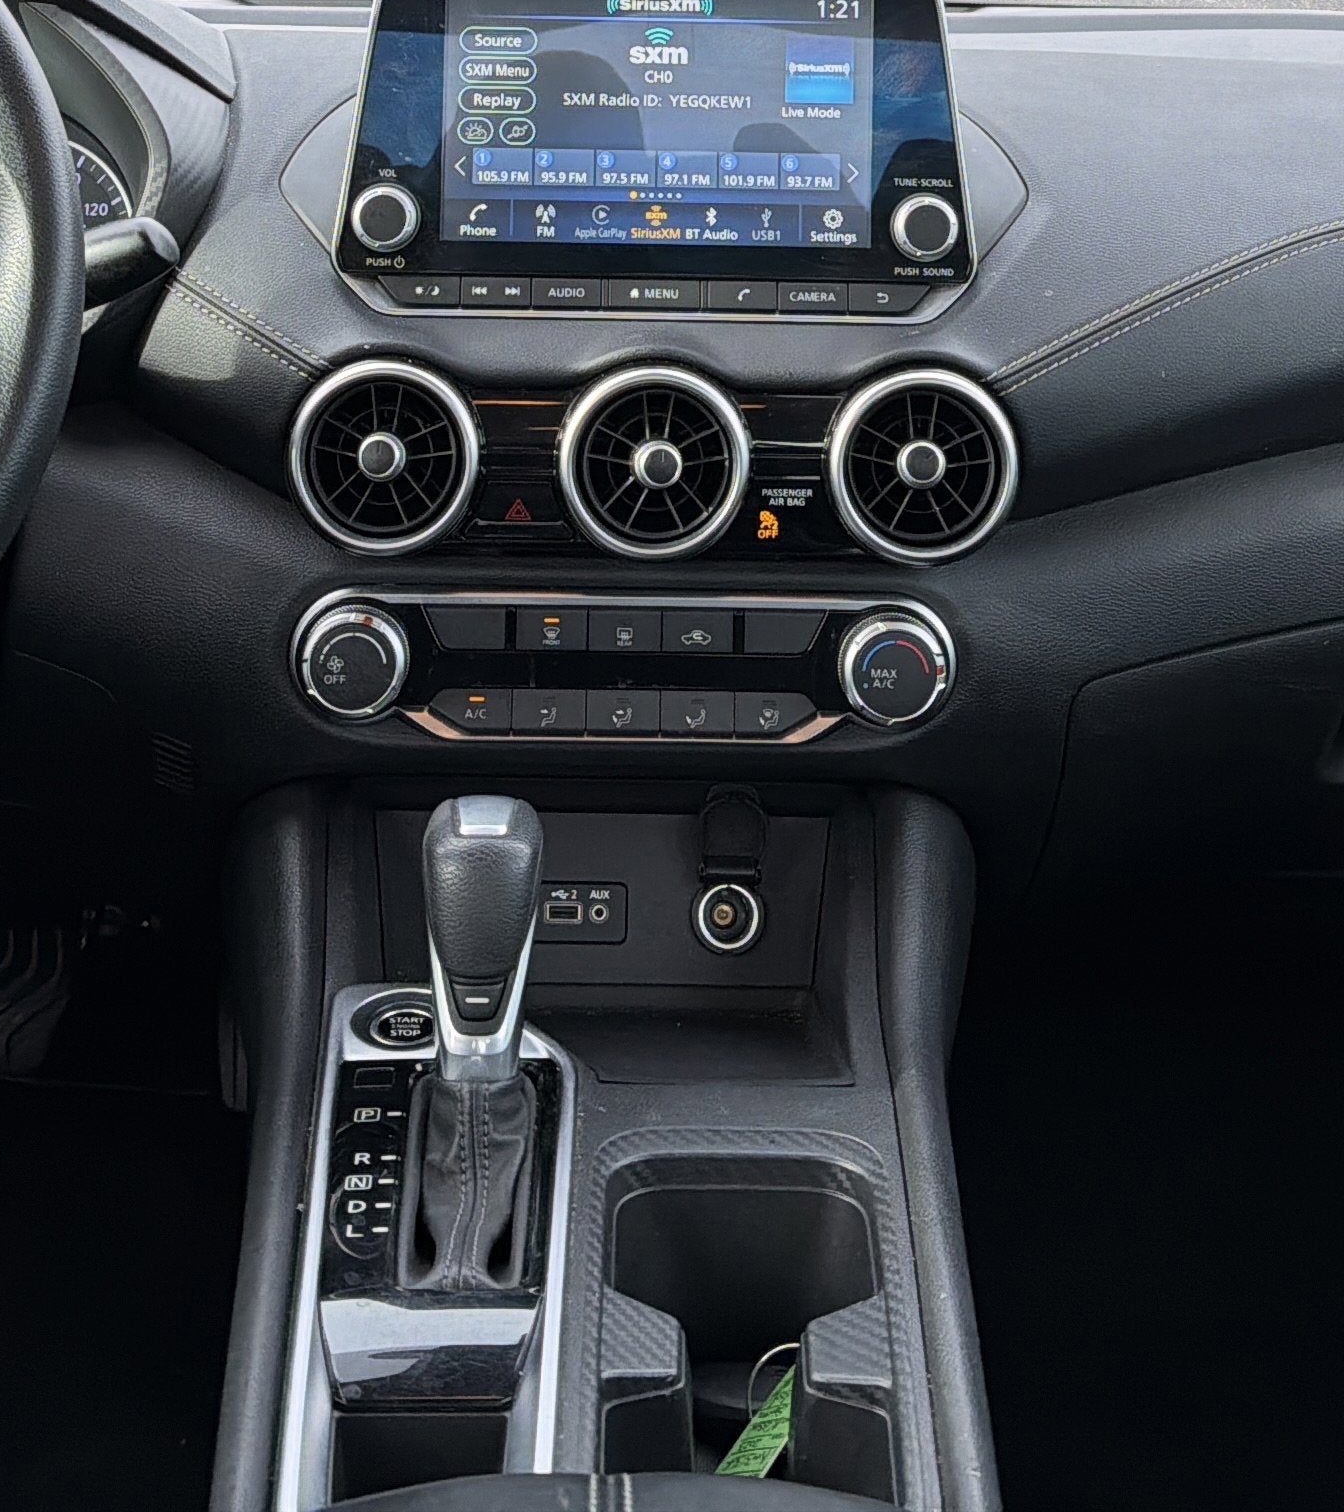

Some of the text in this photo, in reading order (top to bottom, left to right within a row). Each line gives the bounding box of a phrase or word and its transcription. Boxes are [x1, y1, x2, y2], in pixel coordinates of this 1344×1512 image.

[817, 0, 860, 19] 1:21
[474, 34, 522, 49] Source
[465, 64, 530, 77] SXM Menu
[473, 93, 522, 110] Replay
[562, 93, 752, 109] SXM Radio ID: YEGQKEW1
[781, 106, 841, 119] Live Mode
[378, 168, 397, 178] VOL
[476, 170, 530, 183] 105.9 FM
[540, 172, 587, 184] 95.9 FM
[602, 173, 649, 185] 97.5 FM
[664, 174, 711, 186] 97.1 FM
[723, 175, 776, 187] 101.9 FM
[786, 176, 833, 188] 93.7 FM
[83, 202, 109, 217] 120
[459, 225, 497, 237] Phone
[536, 226, 555, 238] FM
[574, 227, 627, 240] Apple CarPlay
[630, 227, 681, 240] SiriusXM
[685, 228, 739, 241] BT Audio
[751, 229, 782, 241] USB1
[810, 230, 858, 246] Settings
[365, 256, 392, 268] PUSH
[893, 266, 954, 278] PUSH SOUND
[547, 287, 586, 299] AUDIO
[644, 288, 680, 300] MENU
[789, 291, 837, 303] CAMERA
[761, 488, 814, 498] PASSENGER
[768, 497, 806, 507] AIR BAG
[757, 529, 779, 539] OFF
[323, 674, 347, 685] OFF
[870, 668, 898, 679] MAX
[872, 678, 896, 689] A/C
[464, 708, 488, 720] A/C
[570, 889, 578, 900] 2
[589, 889, 611, 900] AUX
[388, 1016, 425, 1024] START
[390, 1029, 422, 1037] STOP
[360, 1110, 375, 1121] P
[354, 1152, 371, 1166] R
[350, 1177, 367, 1188] N
[347, 1200, 367, 1214] D
[346, 1224, 365, 1238] L
